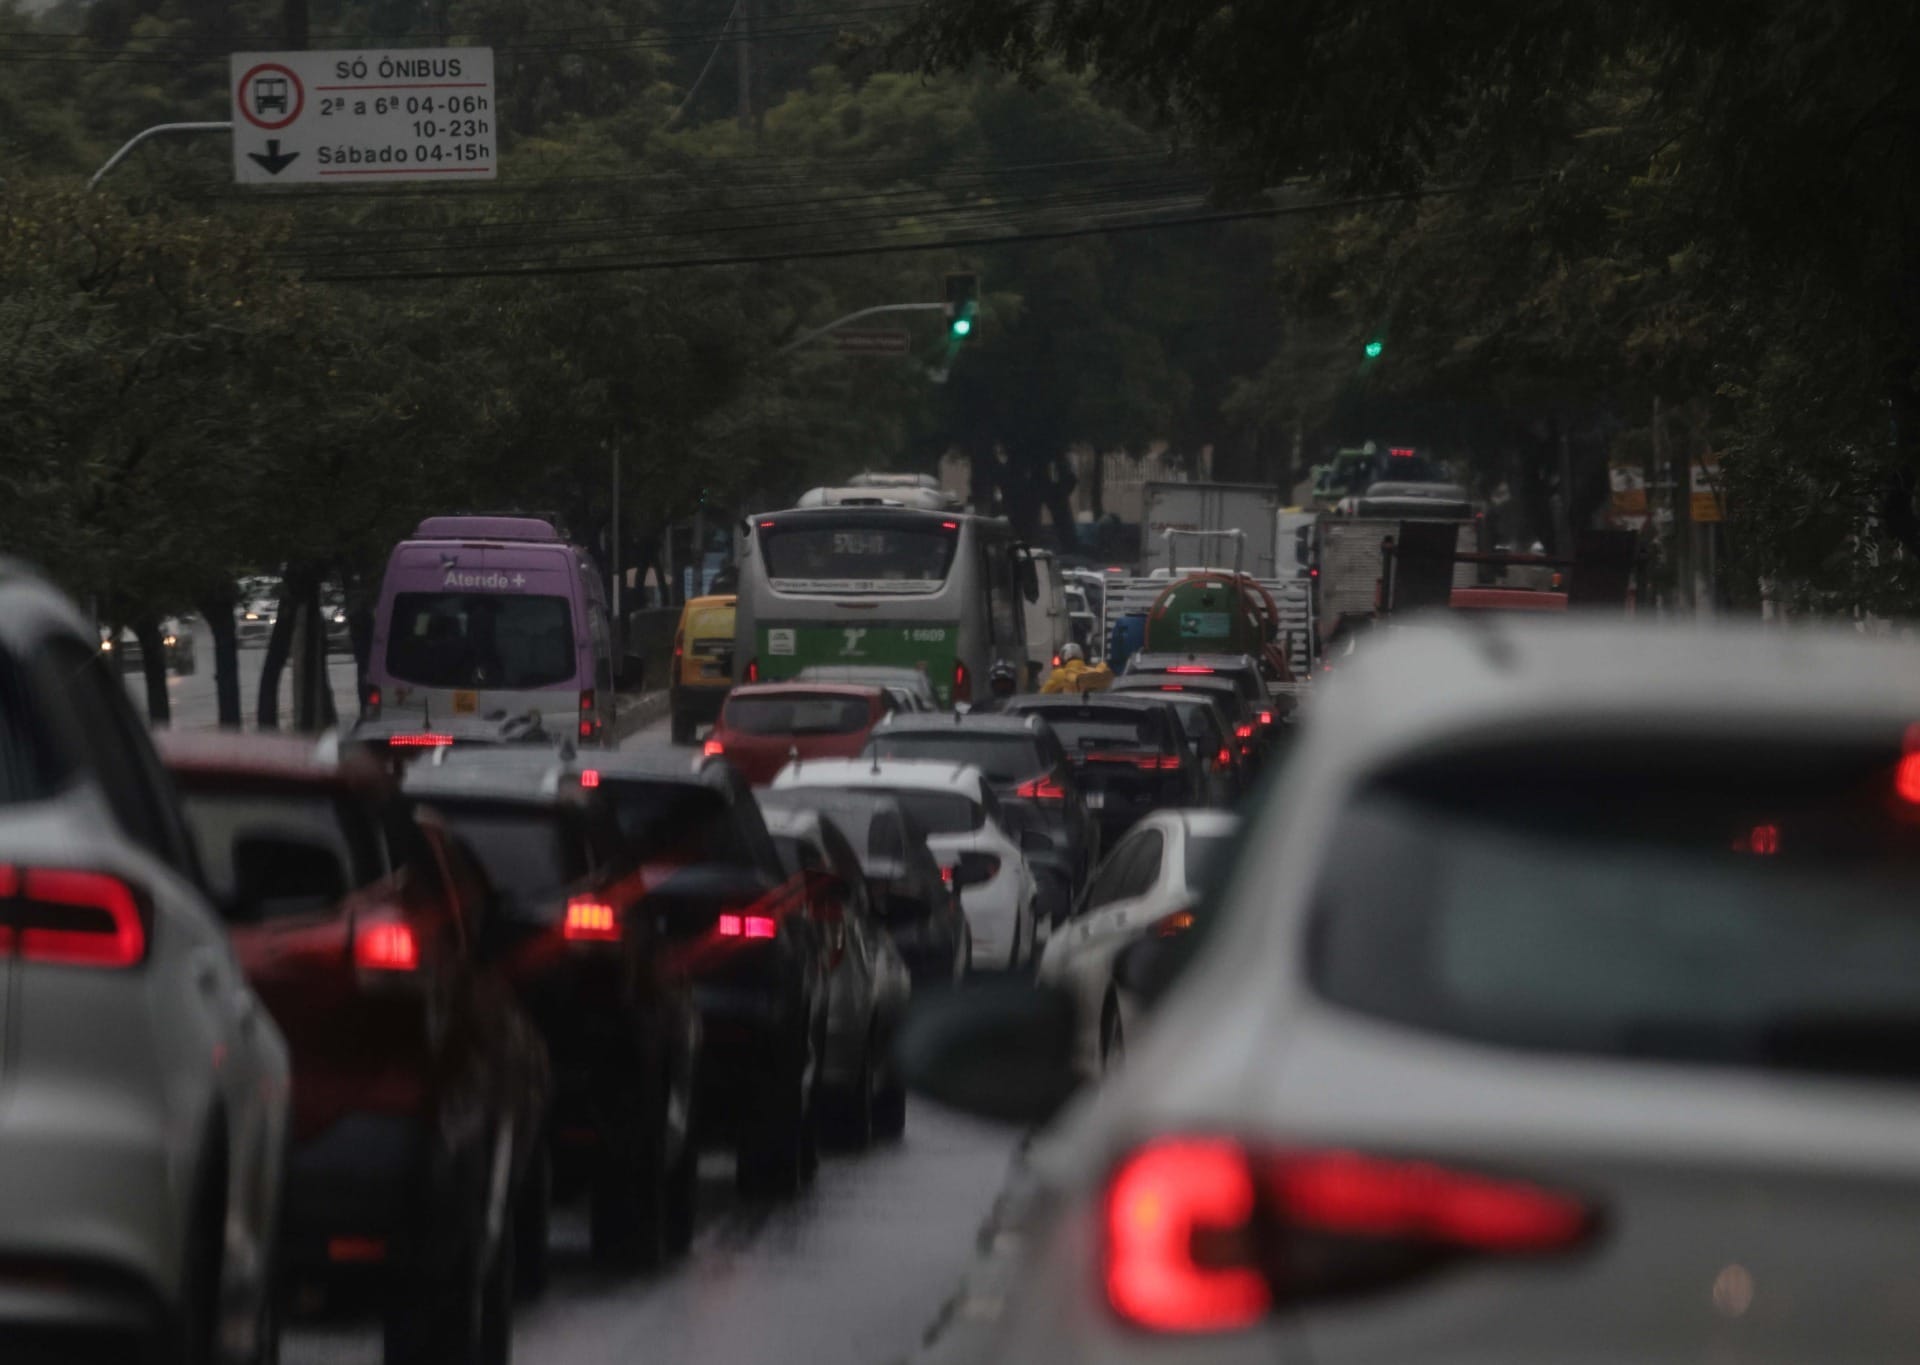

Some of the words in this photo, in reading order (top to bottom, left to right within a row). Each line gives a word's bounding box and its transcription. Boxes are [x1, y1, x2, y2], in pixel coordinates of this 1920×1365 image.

[336, 56, 368, 79] SÓ
[354, 103, 366, 115] a
[406, 96, 488, 115] 04-06h
[413, 120, 489, 138] 10-23h
[317, 145, 408, 164] Sábado
[415, 143, 490, 162] 04-15h
